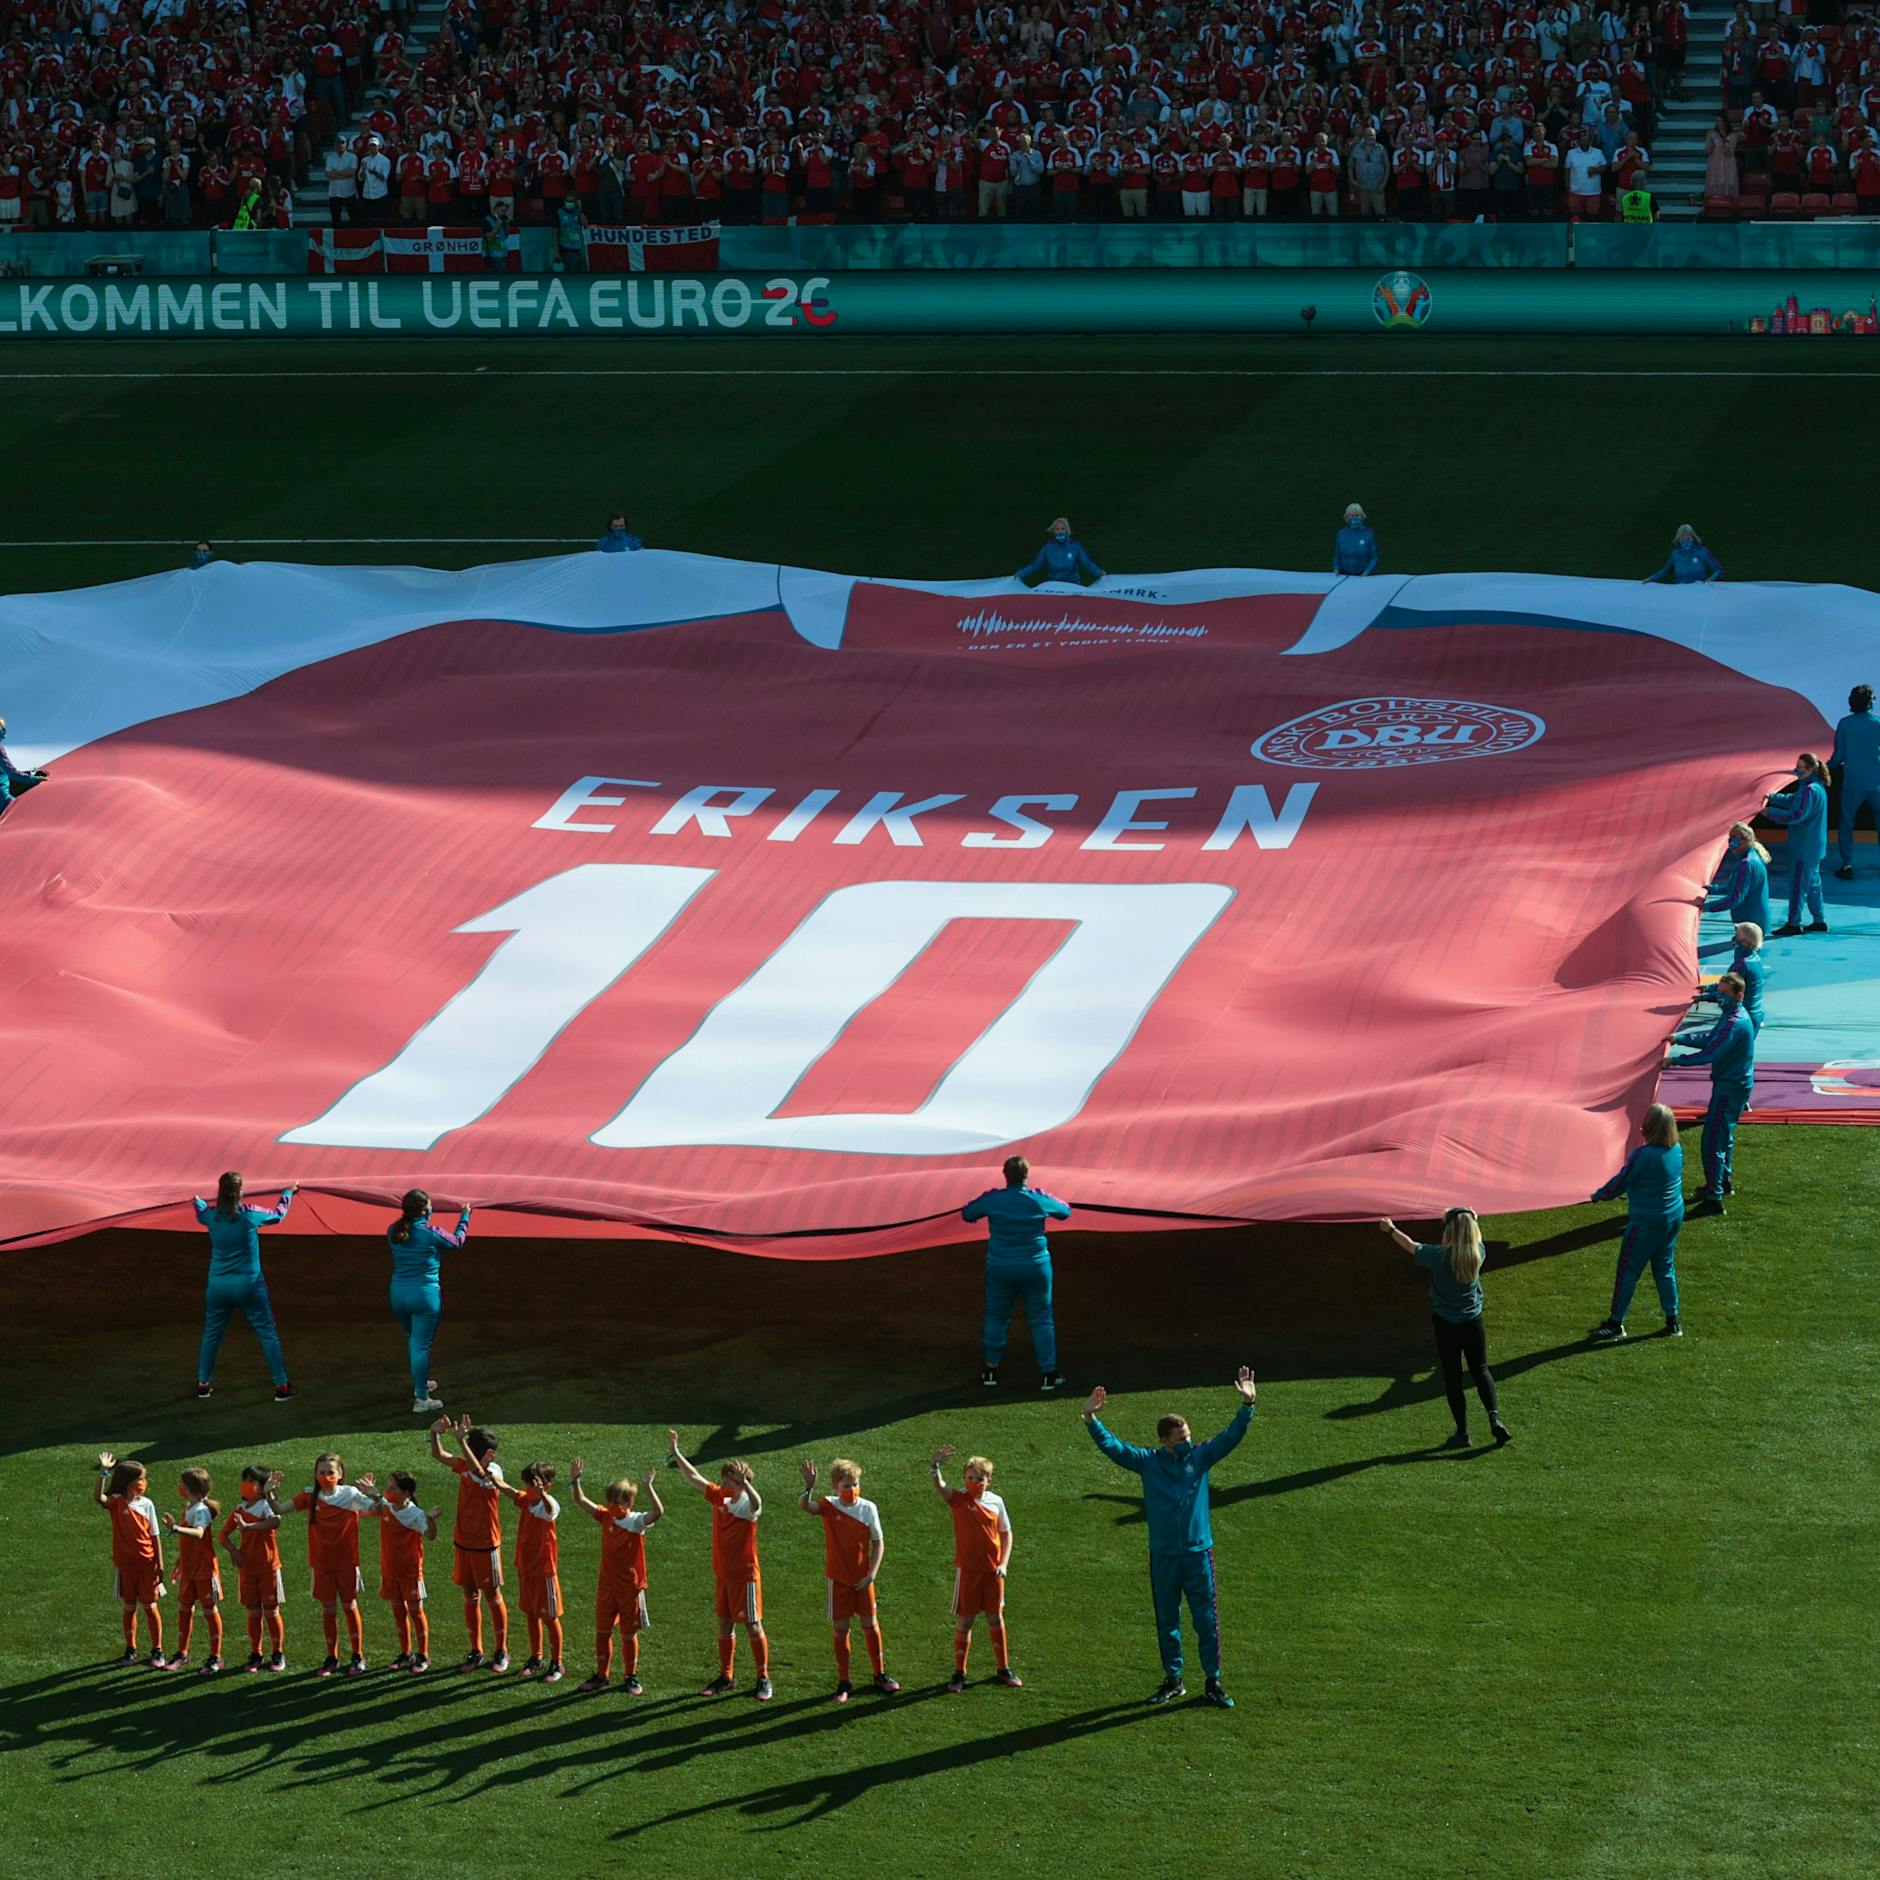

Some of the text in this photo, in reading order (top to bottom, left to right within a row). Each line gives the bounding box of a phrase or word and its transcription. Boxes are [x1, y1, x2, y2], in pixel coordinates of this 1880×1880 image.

[591, 228, 712, 245] HUNDESTED
[308, 281, 402, 329] TIL
[421, 277, 579, 329] UEFA
[1006, 642, 1026, 650] ER
[1032, 641, 1052, 649] ET
[1313, 724, 1483, 751] DBU
[533, 776, 1320, 851] ERIKSEN
[275, 862, 1237, 1156] 10
